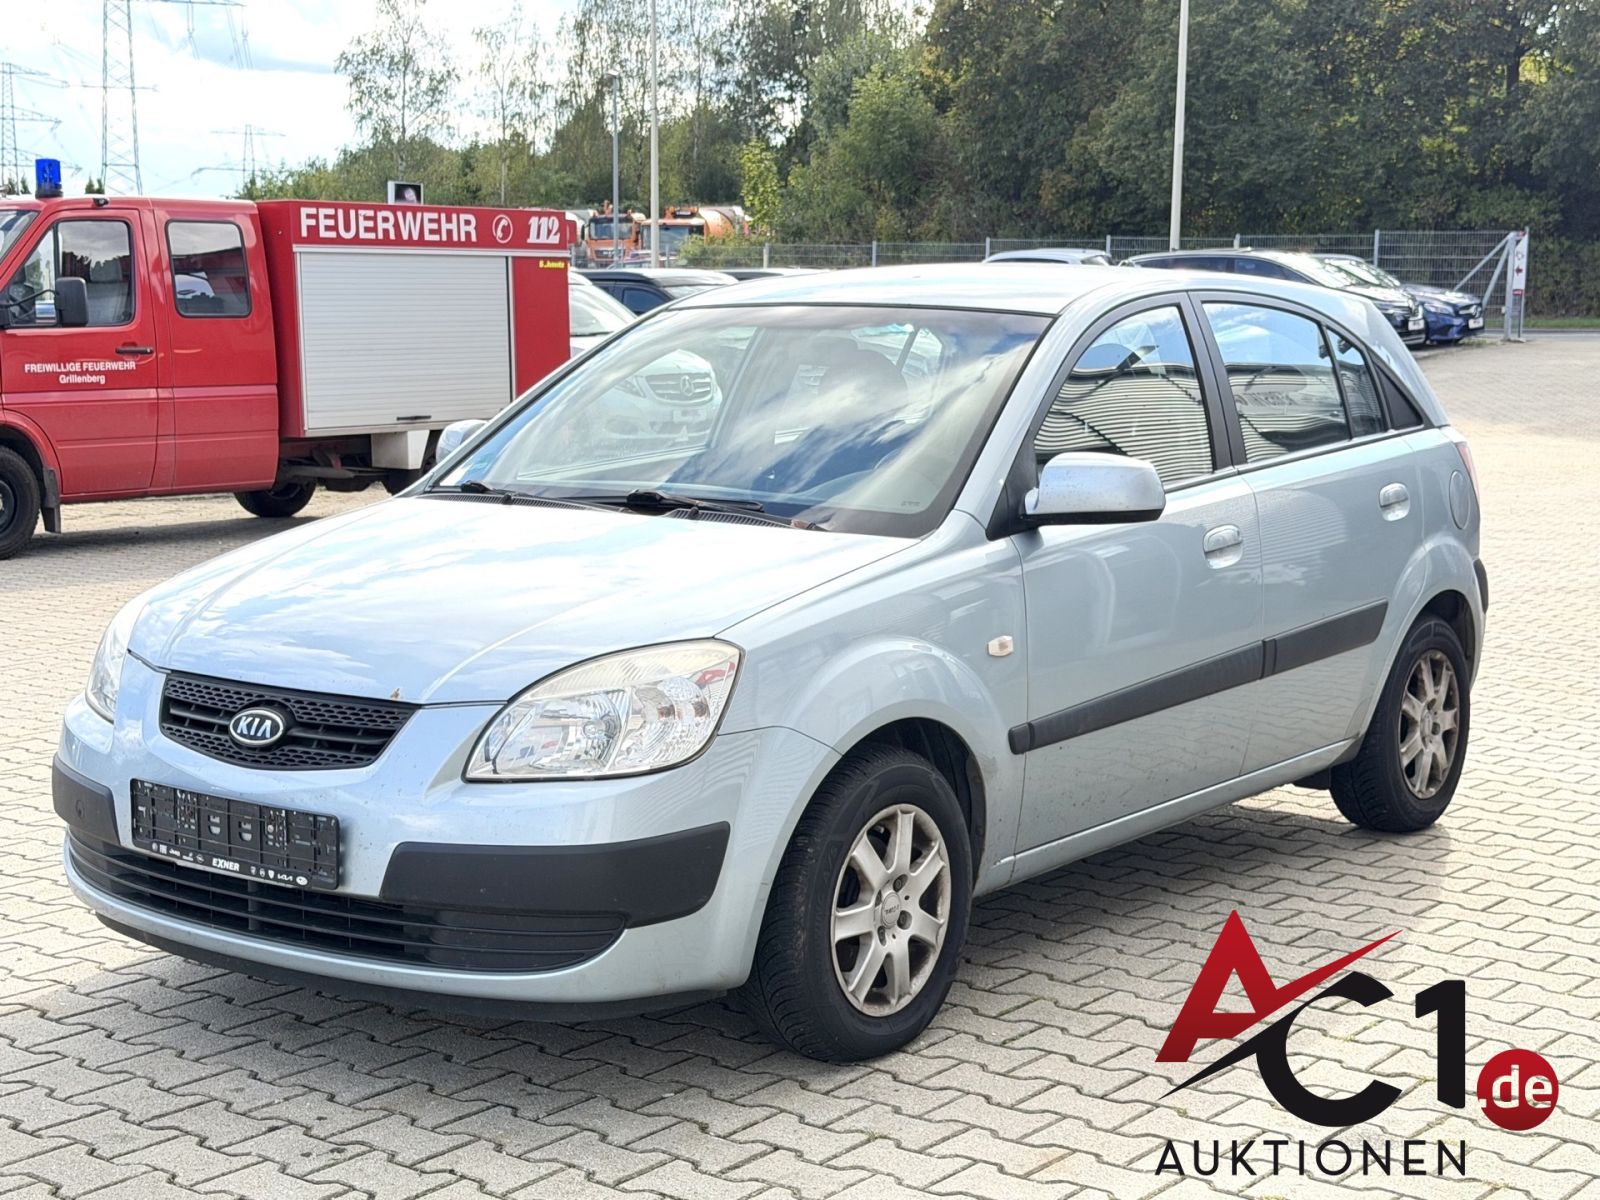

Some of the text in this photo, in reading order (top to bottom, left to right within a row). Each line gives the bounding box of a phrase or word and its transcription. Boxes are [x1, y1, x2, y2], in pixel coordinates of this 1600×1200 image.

[300, 207, 560, 244] FEUERWEHR 112
[24, 361, 136, 373] FREIWILLIGE FEUERWEHR
[59, 373, 105, 384] Grillenberg
[236, 716, 272, 738] KIA
[212, 857, 240, 872] EXNER
